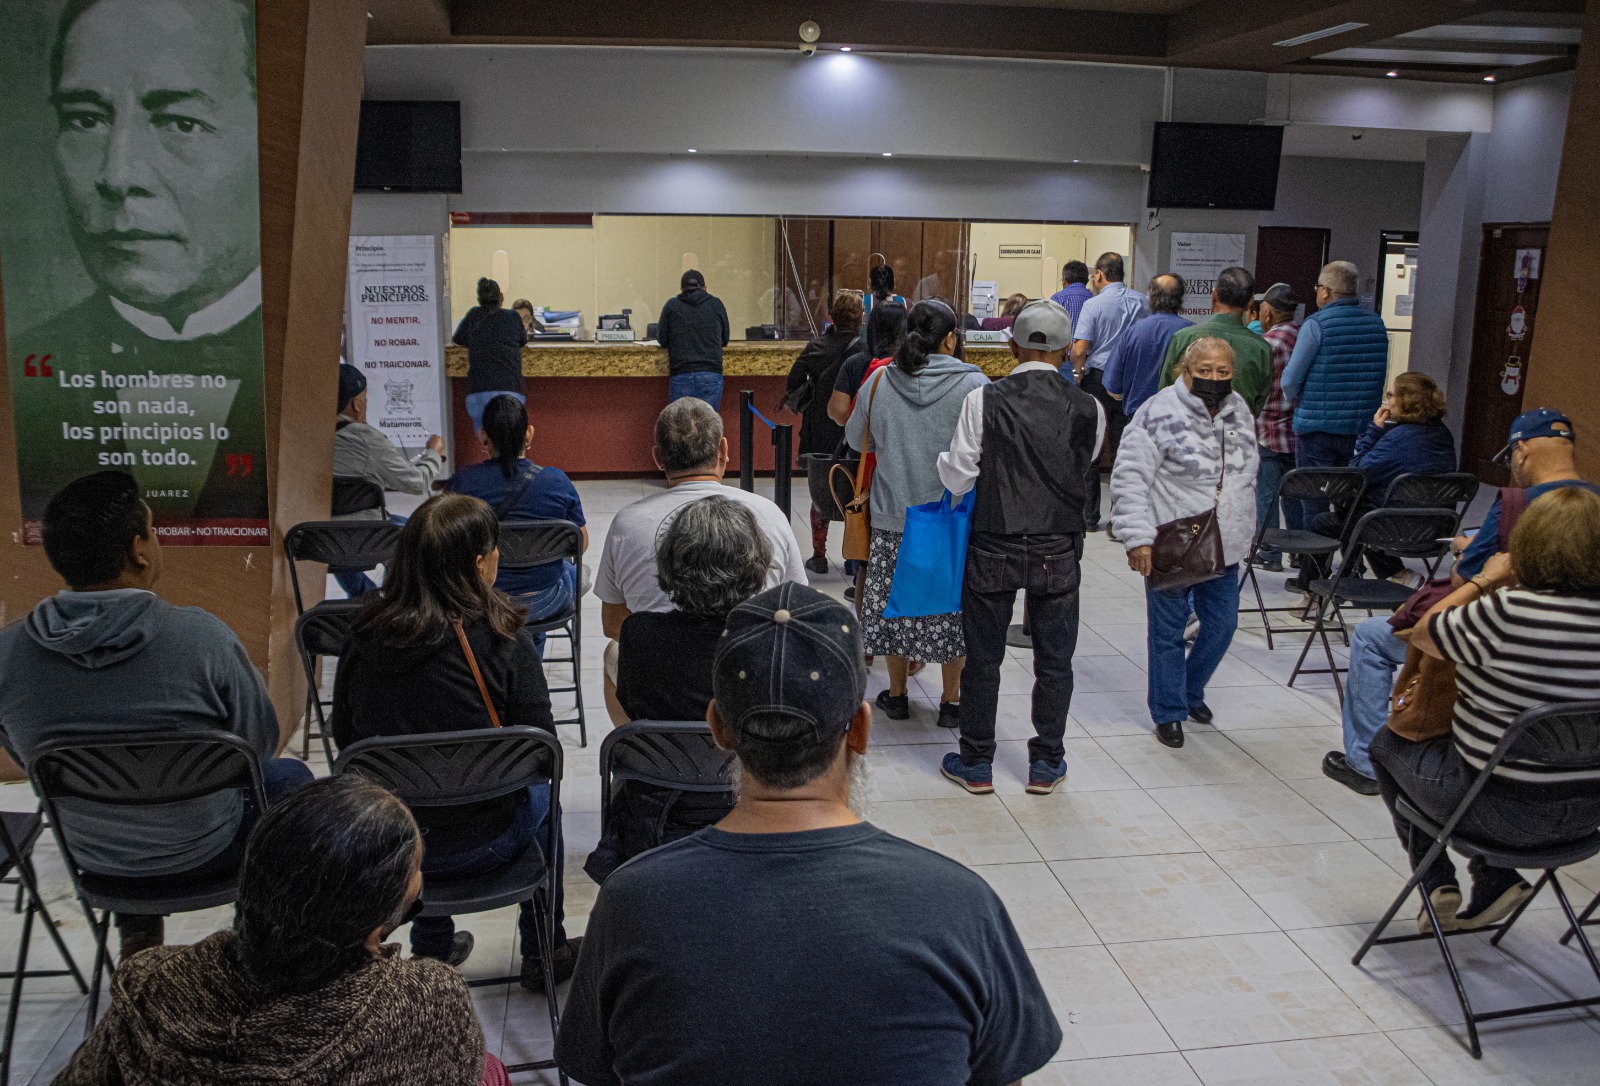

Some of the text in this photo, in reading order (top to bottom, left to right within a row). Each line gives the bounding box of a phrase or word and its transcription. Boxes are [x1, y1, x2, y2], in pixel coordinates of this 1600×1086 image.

[364, 285, 425, 294] NUESTROS
[361, 293, 429, 303] PRINCIPIOS:
[386, 316, 420, 324] MENTIR.
[389, 338, 420, 346] ROBAR.
[364, 360, 431, 369] NO TRAICIONAR.
[58, 370, 95, 388] Los
[101, 370, 195, 388] hombres
[201, 375, 227, 388] no
[93, 396, 195, 417] son nada,
[379, 420, 422, 428] Matamoros
[62, 422, 229, 445] los principios lo
[98, 451, 136, 466] son
[142, 448, 196, 466] todo.
[145, 490, 189, 498] JUAREZ
[158, 527, 190, 536] ROBAR
[196, 527, 211, 536] NO
[212, 527, 268, 536] TRAICIONAR
